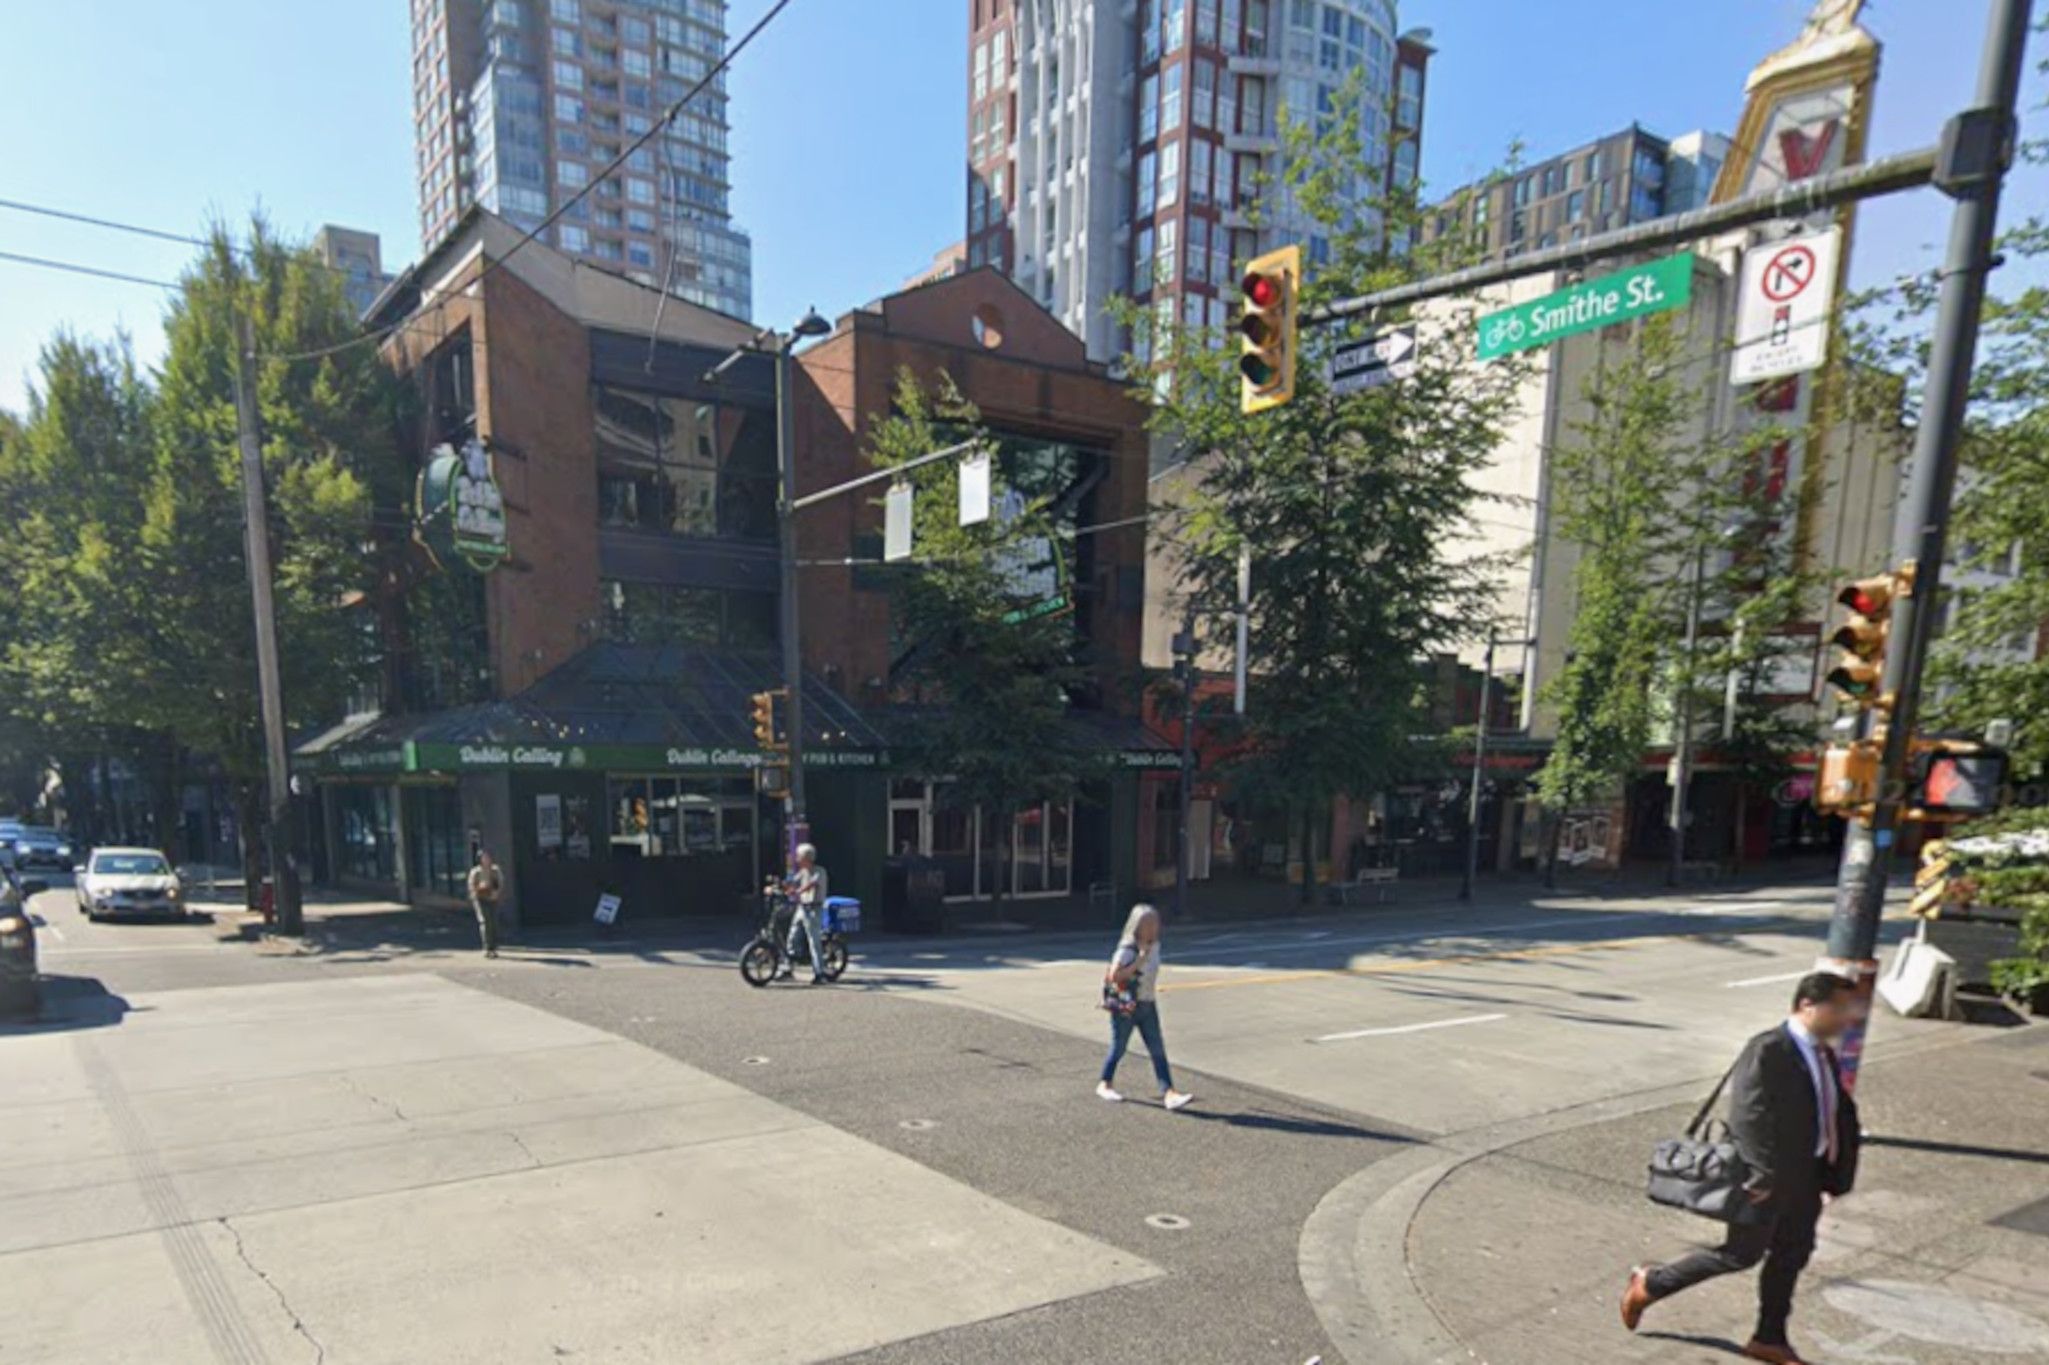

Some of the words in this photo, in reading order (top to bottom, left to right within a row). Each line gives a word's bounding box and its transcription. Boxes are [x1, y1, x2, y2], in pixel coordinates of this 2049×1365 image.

[1530, 288, 1620, 337] Smithe
[1626, 273, 1665, 309] St.
[459, 744, 507, 763] Dublin
[512, 745, 564, 767] Calling
[666, 747, 708, 765] Dublin
